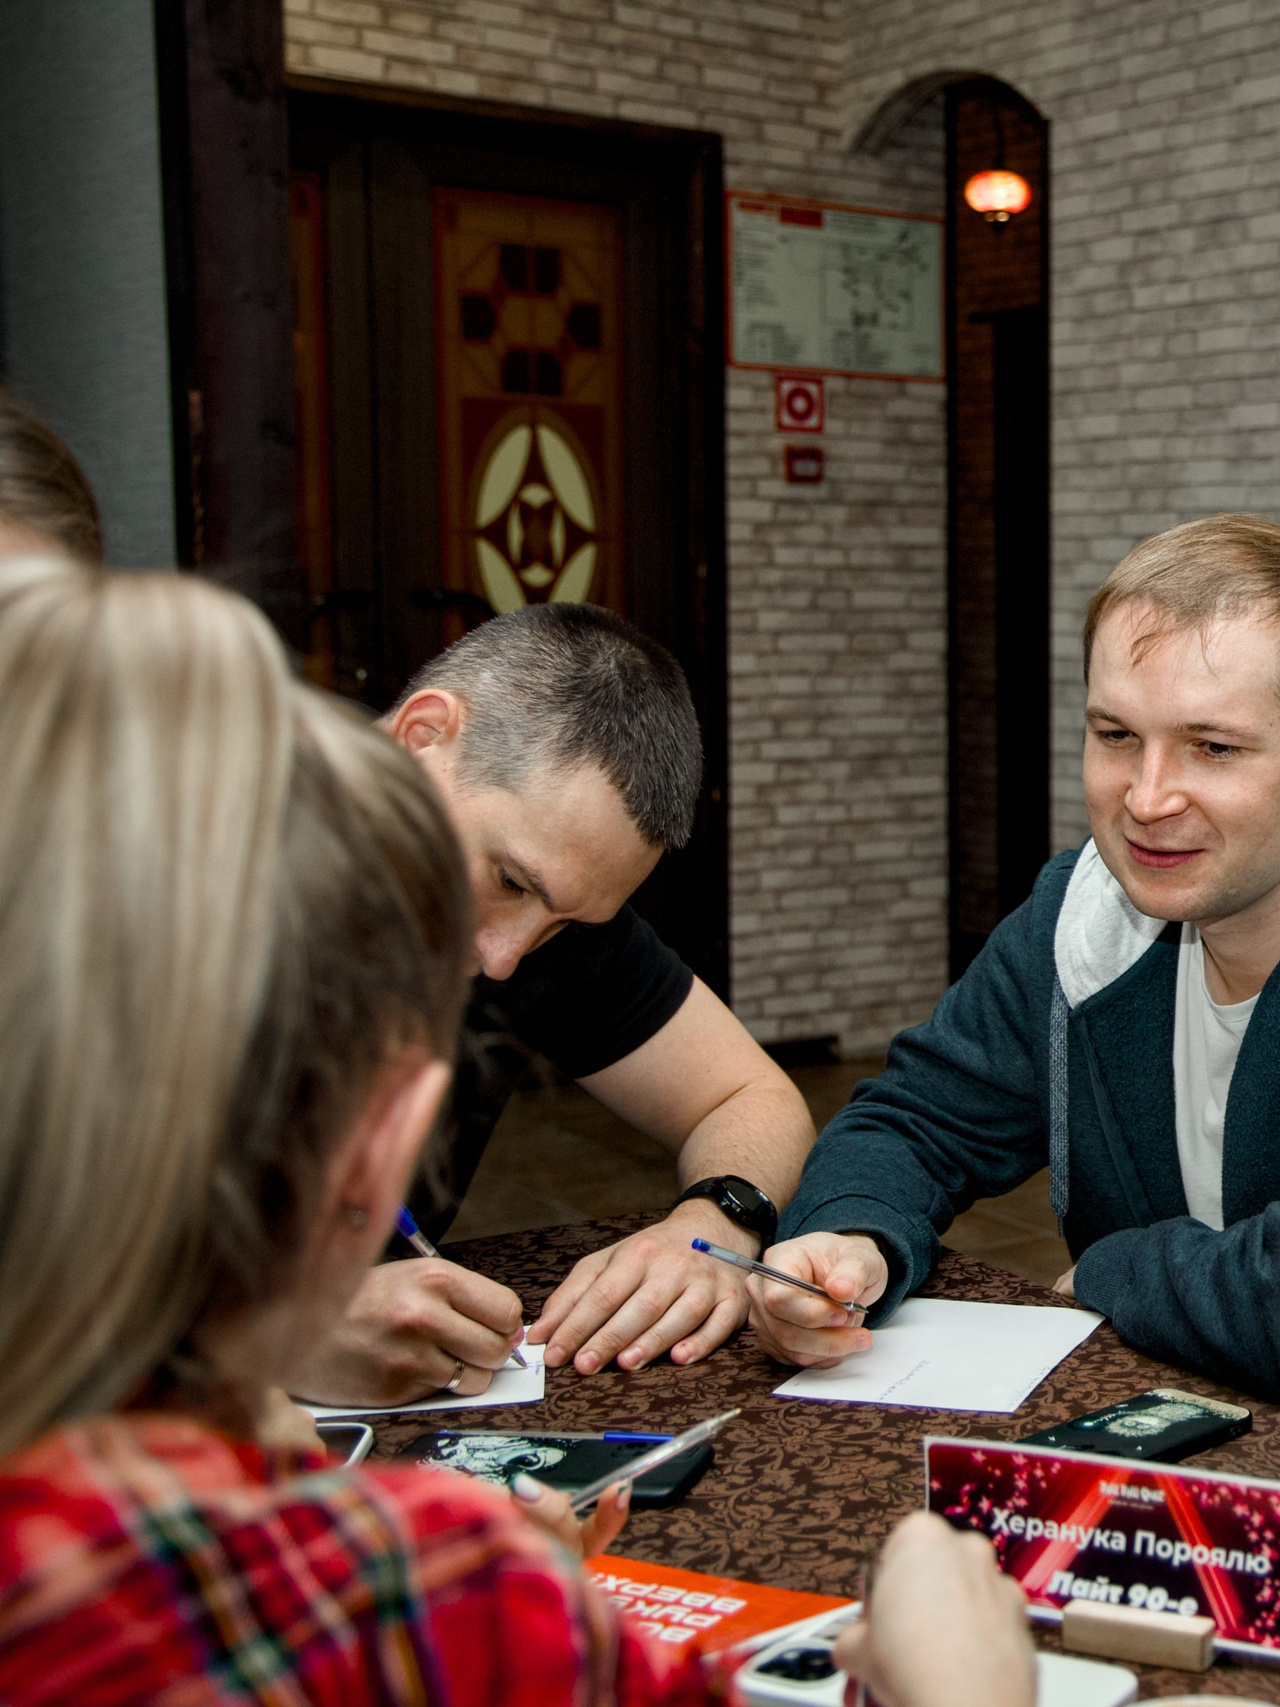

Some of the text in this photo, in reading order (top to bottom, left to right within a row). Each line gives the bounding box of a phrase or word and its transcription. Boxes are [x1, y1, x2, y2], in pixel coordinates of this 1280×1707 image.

[991, 1508, 1271, 1574] Херанука Пороялю
[1047, 1571, 1199, 1617] Лайт 90-е
